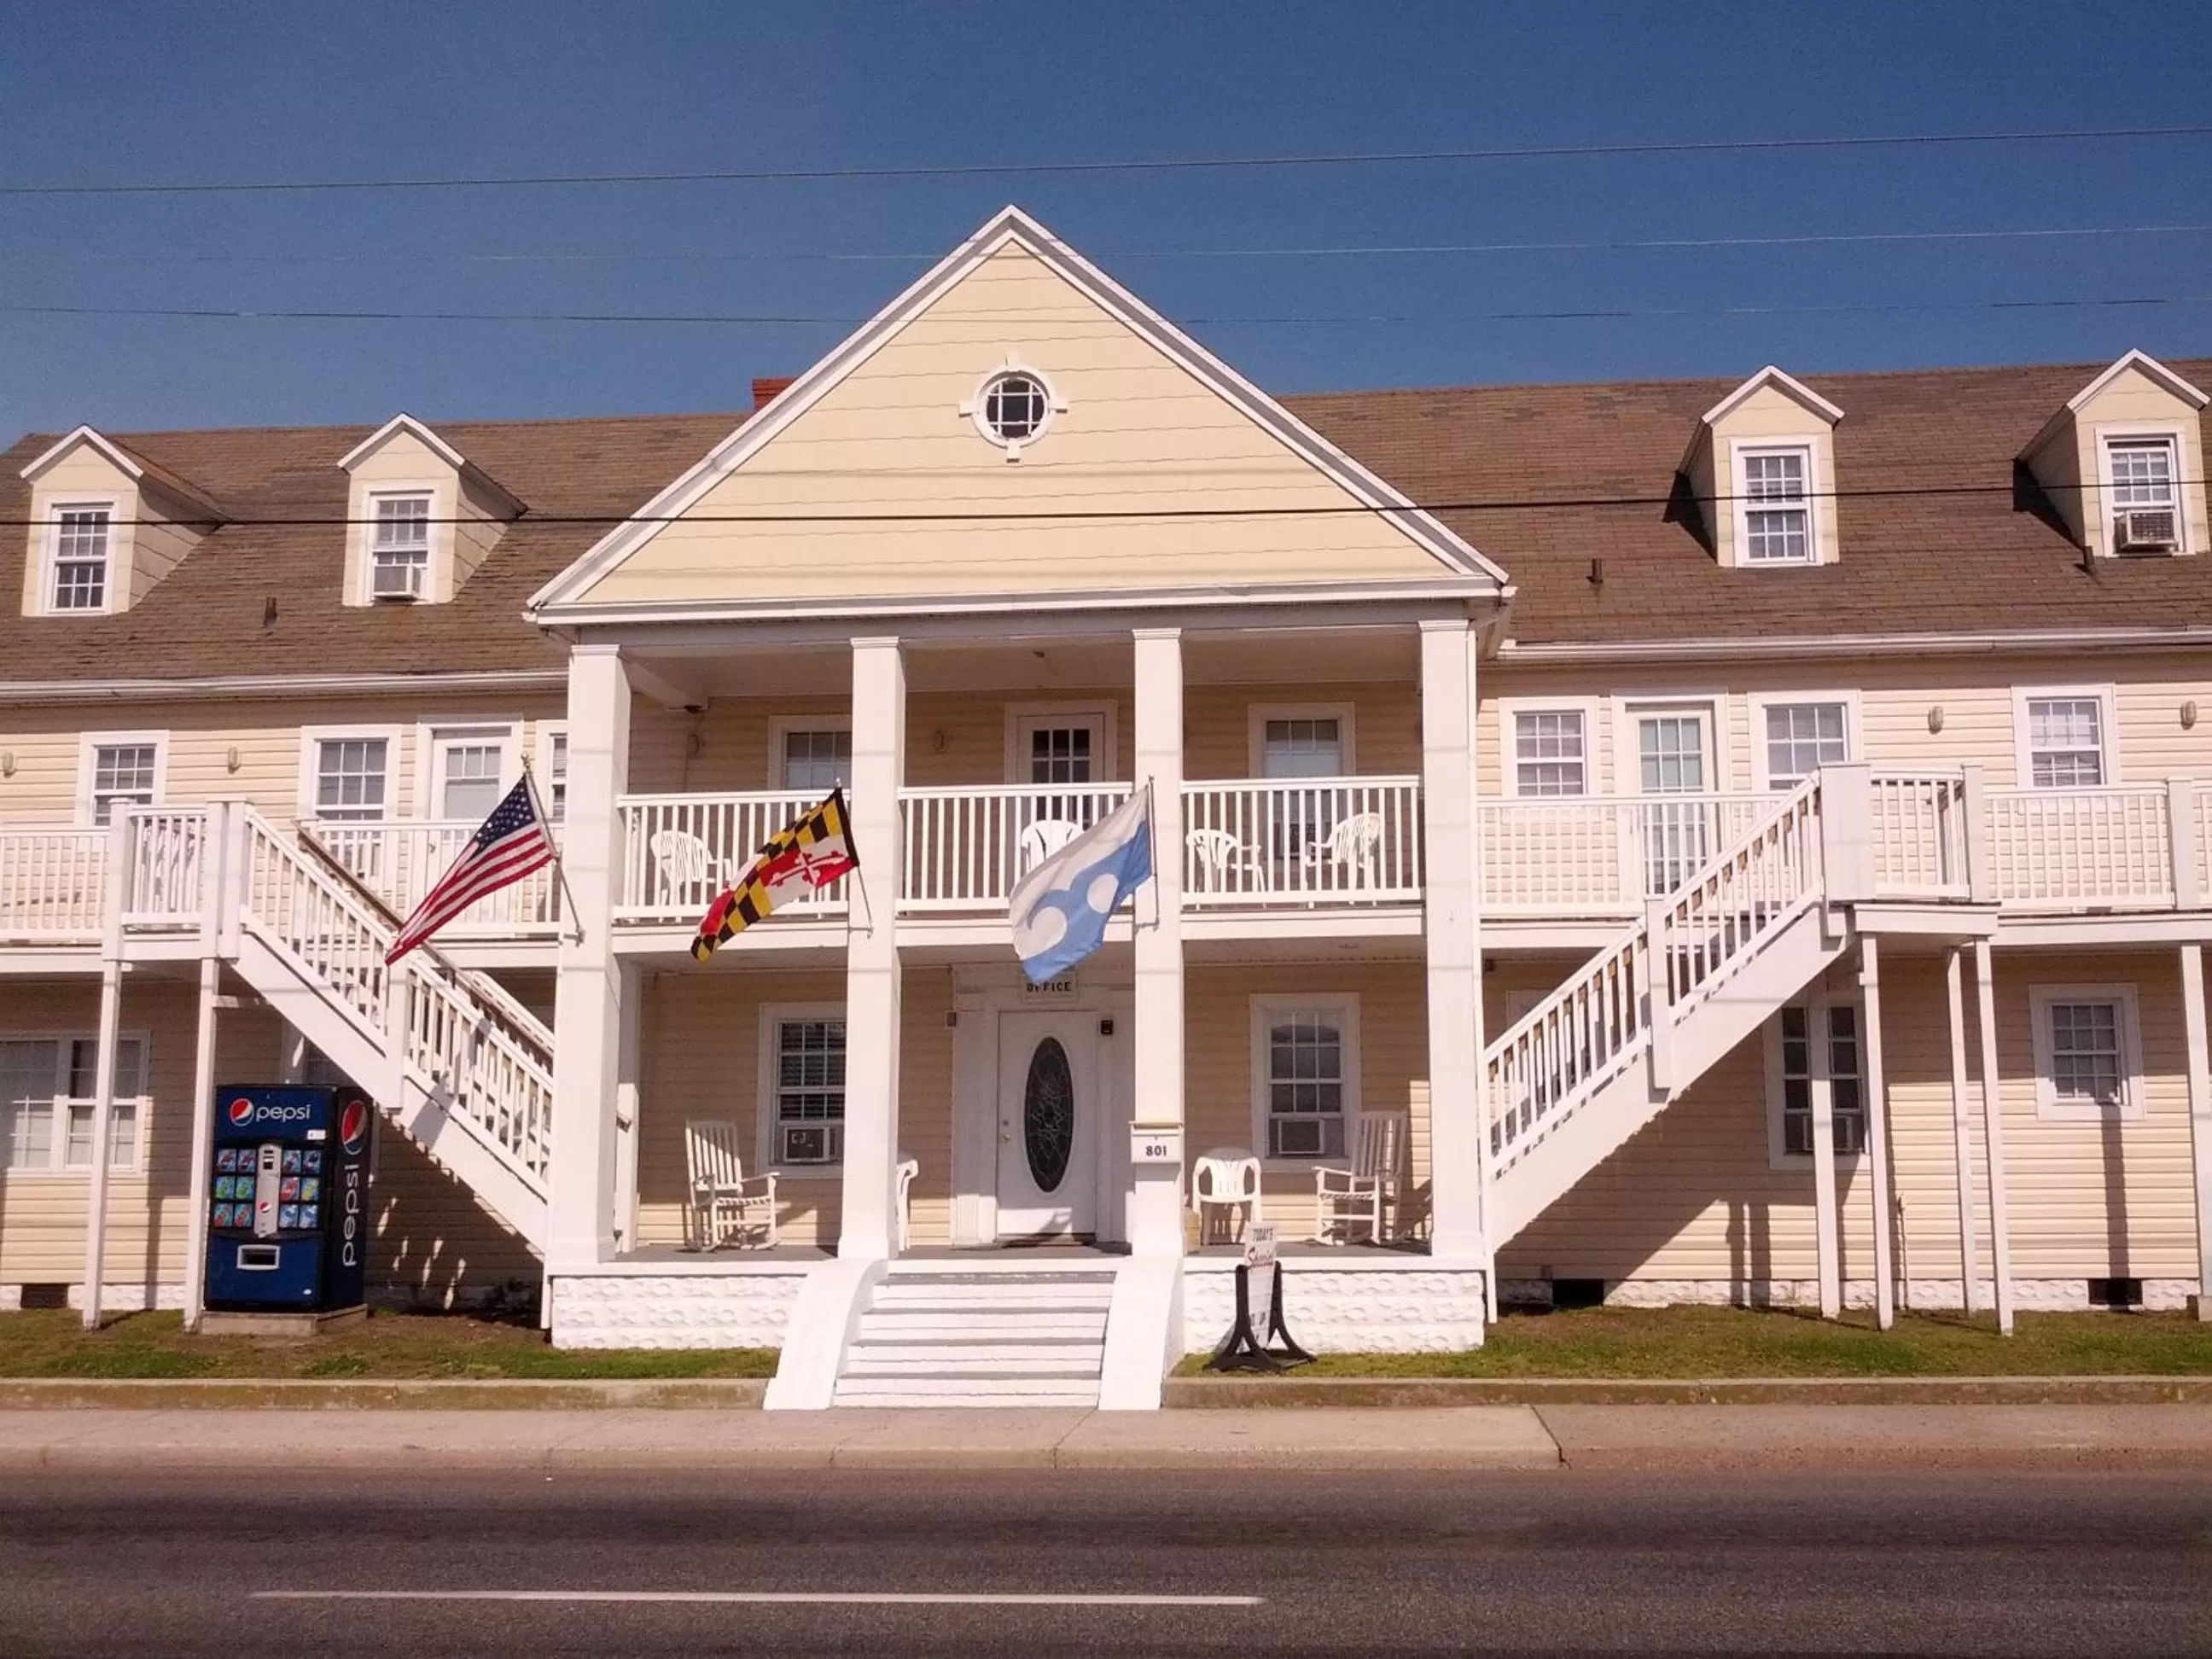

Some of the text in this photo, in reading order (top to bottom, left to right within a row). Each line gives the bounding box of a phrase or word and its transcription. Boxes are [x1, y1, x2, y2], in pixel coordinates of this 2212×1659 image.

[256, 1104, 311, 1121] pepsi
[1145, 1145, 1167, 1156] 801
[342, 1163, 359, 1266] pepsi
